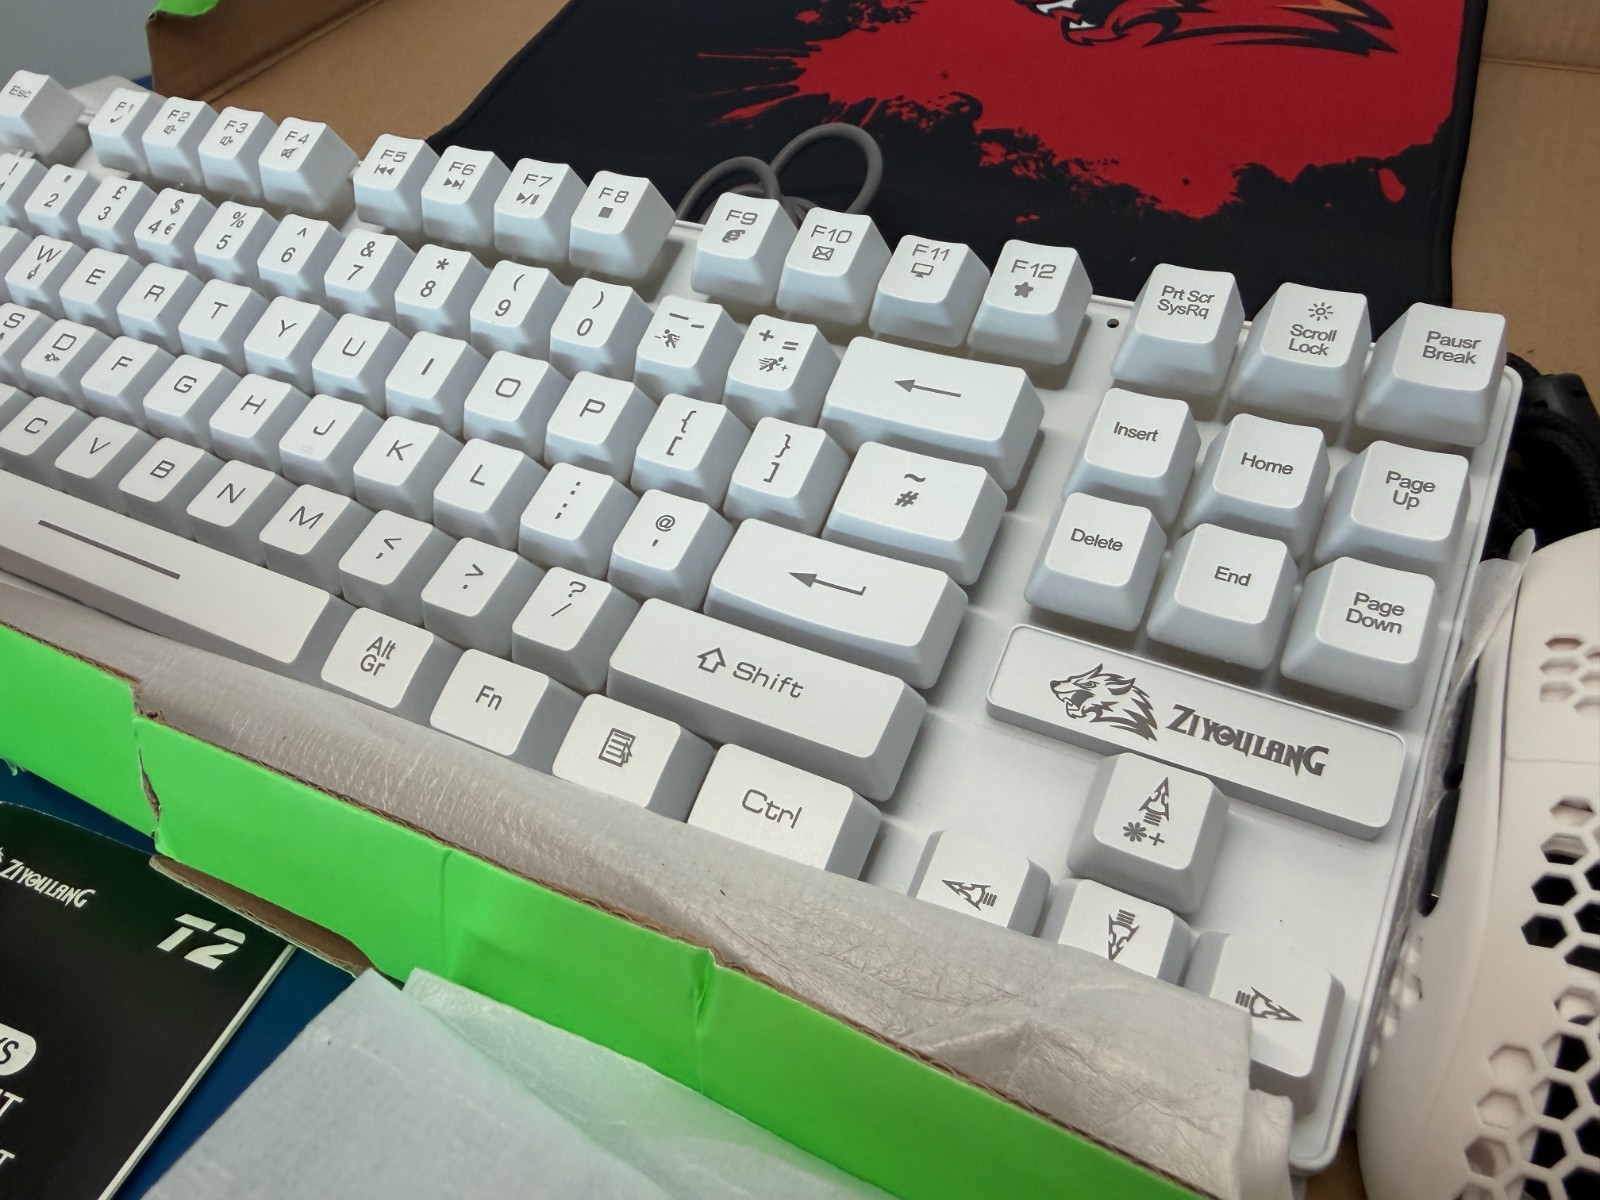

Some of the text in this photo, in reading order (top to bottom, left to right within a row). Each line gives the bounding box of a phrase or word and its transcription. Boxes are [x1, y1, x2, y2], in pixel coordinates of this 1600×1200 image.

[9, 86, 31, 98] Esc
[115, 102, 134, 112] F1
[168, 110, 190, 122] F2
[224, 120, 248, 133] F3
[285, 131, 309, 144] F4
[380, 149, 407, 162] F5
[449, 161, 476, 175] F6
[523, 174, 552, 187] F7
[44, 193, 59, 207] 2
[112, 186, 127, 200] £
[599, 187, 629, 203] F8
[98, 206, 111, 220] 3
[170, 199, 184, 215] $
[230, 212, 247, 228] %
[726, 209, 758, 225] F9
[148, 220, 162, 234] 4
[811, 225, 852, 243] F10
[217, 235, 231, 249] 5
[361, 241, 375, 257] &
[37, 245, 62, 263] W
[281, 247, 295, 263] 6
[912, 244, 949, 261] F11
[86, 269, 105, 285] E
[348, 264, 363, 280] 7
[1011, 259, 1056, 279] F12
[144, 285, 165, 301] R
[420, 281, 436, 297] 8
[1161, 285, 1215, 304] Prt Scr
[211, 302, 228, 319] T
[495, 299, 511, 316] 9
[1157, 298, 1210, 320] SysRq
[3, 313, 25, 328] S
[279, 320, 297, 337] Y
[577, 318, 593, 336] 0
[52, 333, 77, 351] D
[1290, 323, 1338, 343] Scroll
[1426, 330, 1481, 350] Pausr
[342, 338, 365, 357] U
[1288, 337, 1330, 357] Lock
[1422, 344, 1477, 366] Break
[111, 356, 133, 370] F
[421, 358, 434, 375] I
[174, 376, 197, 393] G
[495, 378, 521, 398] O
[241, 395, 266, 414] H
[579, 399, 605, 417] P
[24, 418, 48, 434] C
[313, 420, 335, 435] J
[1114, 422, 1158, 441] Insert
[90, 437, 110, 454] V
[386, 440, 413, 461] K
[666, 436, 682, 456] [
[150, 460, 175, 478] B
[1241, 452, 1293, 474] Home
[470, 465, 485, 486] L
[763, 462, 780, 483] ]
[1385, 470, 1436, 495] Page
[217, 483, 246, 503] N
[895, 491, 919, 507] #
[1392, 490, 1420, 510] Up
[289, 506, 324, 529] M
[656, 515, 675, 532] @
[1071, 528, 1123, 551] Delete
[1214, 566, 1251, 586] End
[568, 581, 586, 597] ?
[1353, 592, 1405, 618] Page
[1346, 608, 1403, 635] Down
[366, 636, 396, 661] Alt
[360, 654, 386, 677] Gr
[733, 662, 803, 698] Shift
[475, 685, 502, 710] Fn
[1165, 704, 1329, 776] ZIYOULANG
[742, 789, 802, 829] Ctrl
[0, 859, 96, 908] ZIYOULANG
[157, 914, 246, 969] T2
